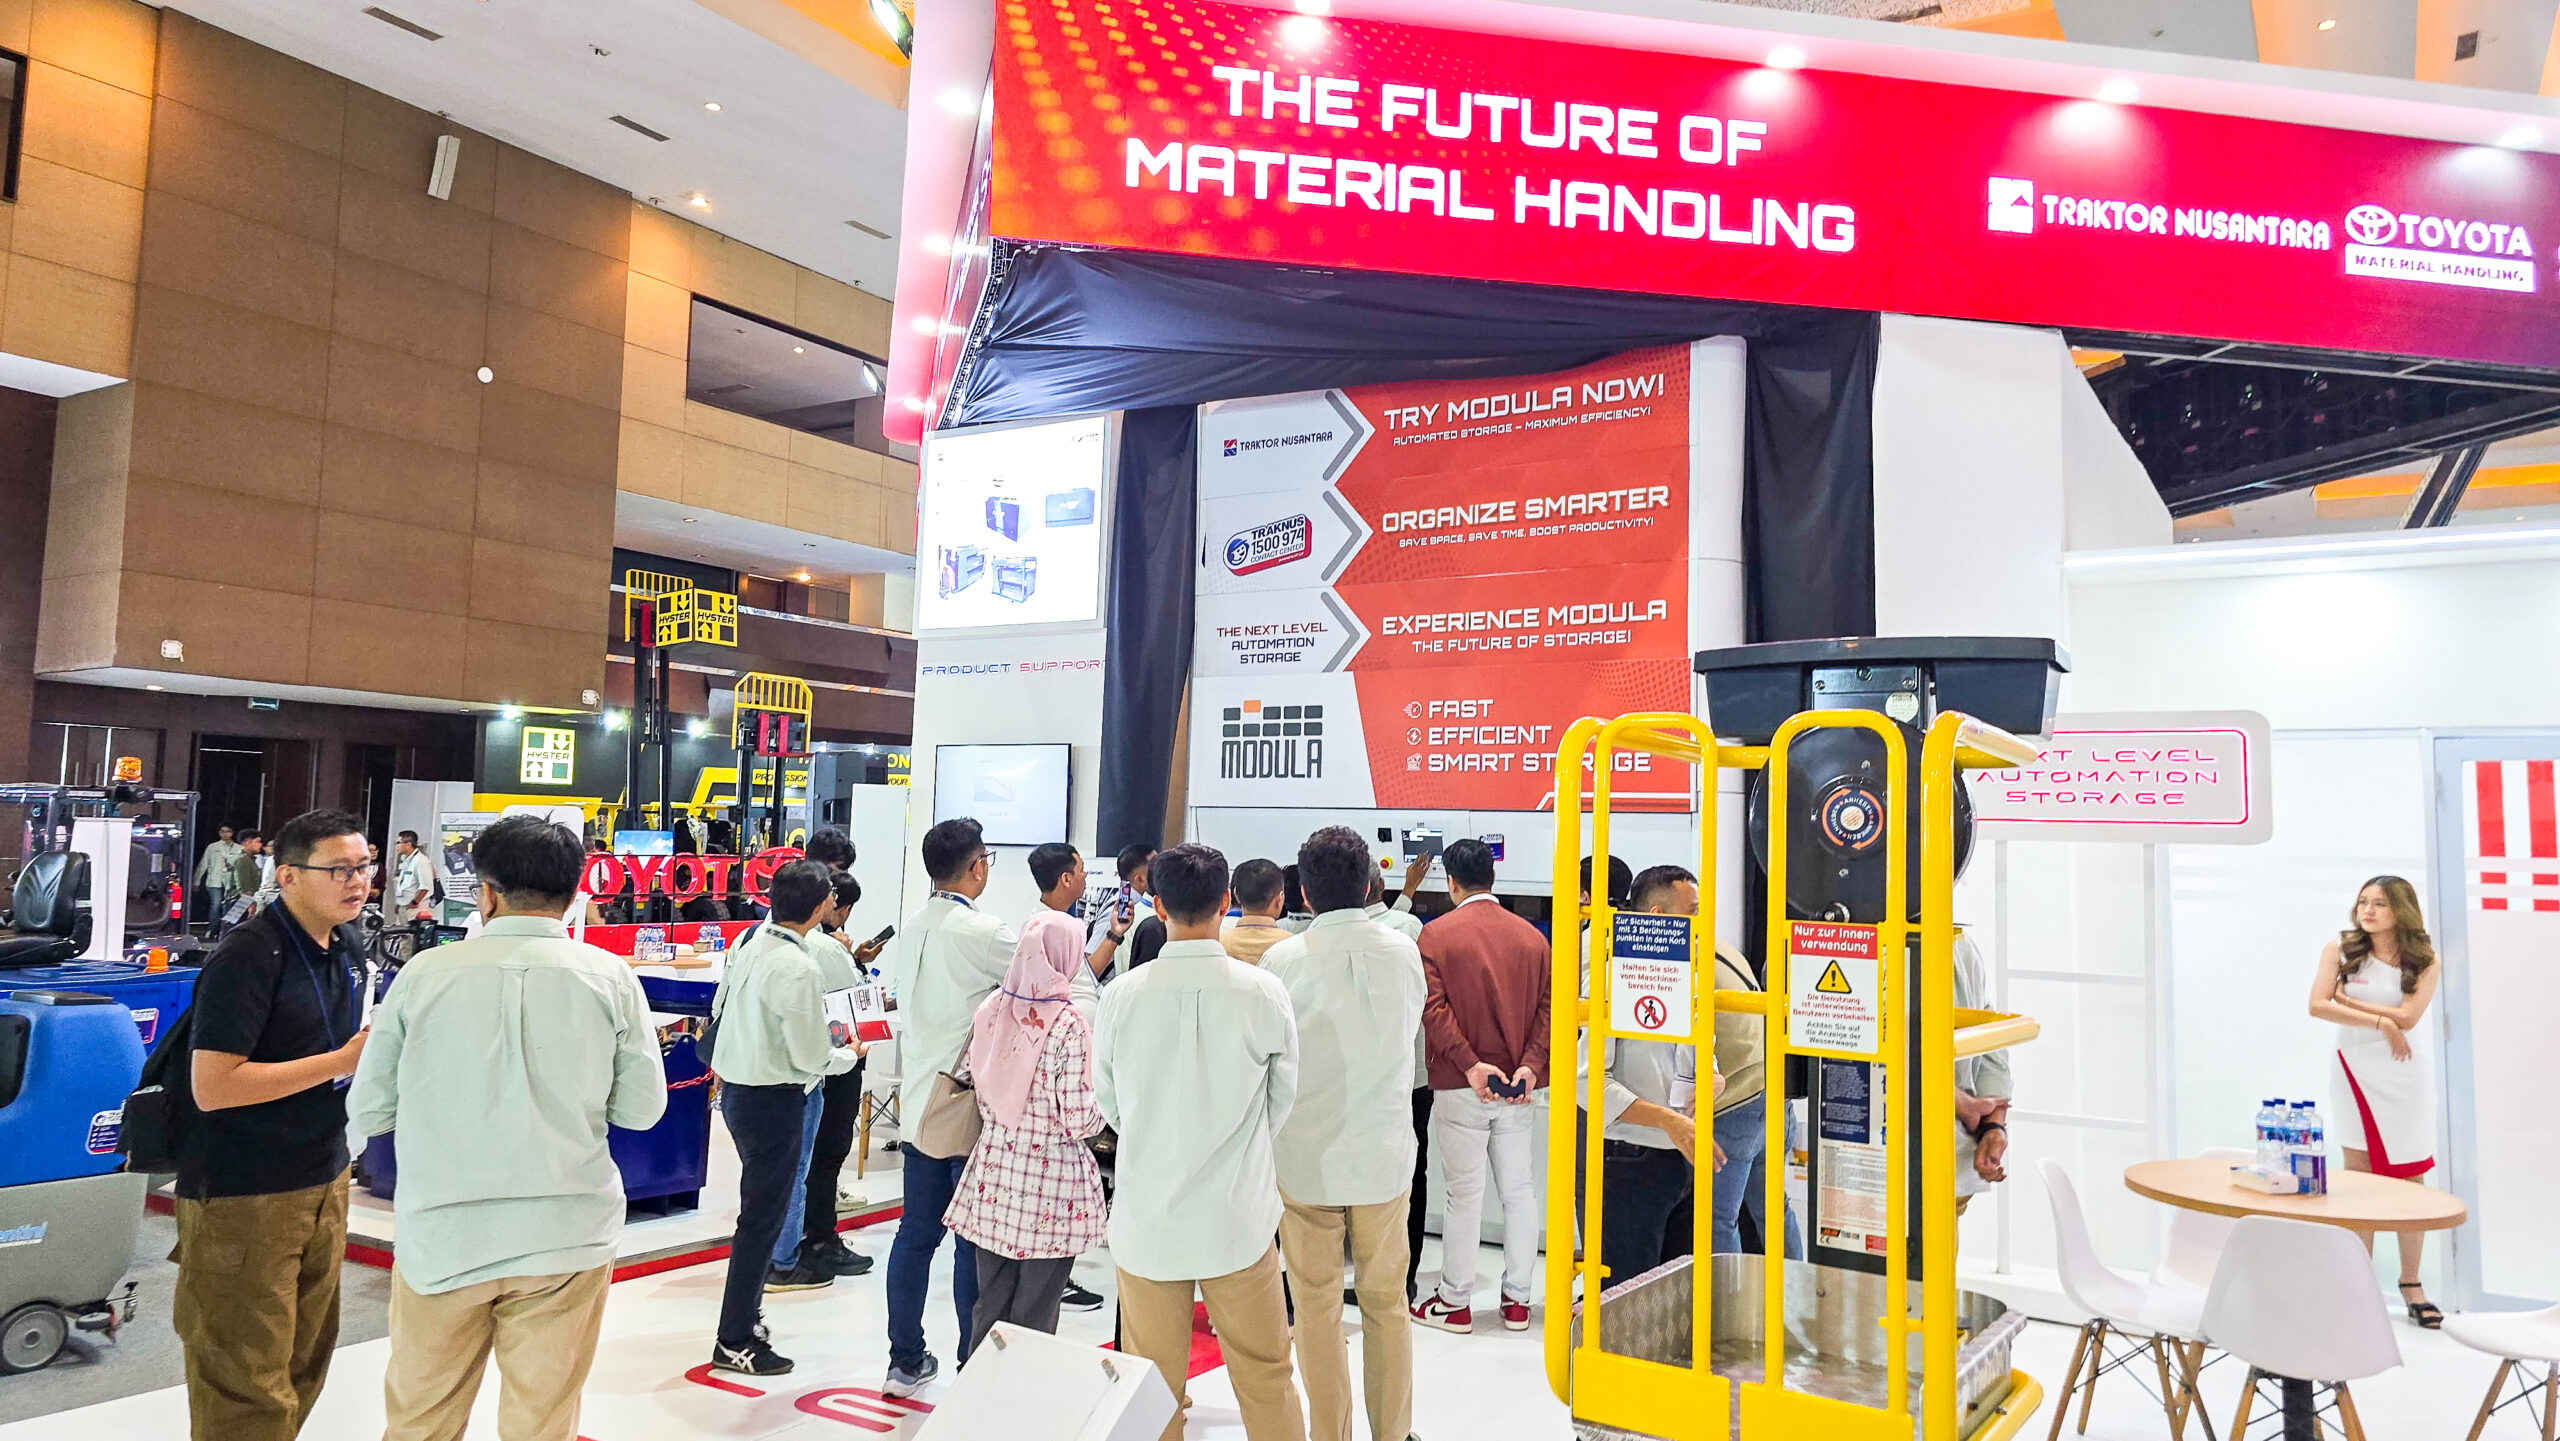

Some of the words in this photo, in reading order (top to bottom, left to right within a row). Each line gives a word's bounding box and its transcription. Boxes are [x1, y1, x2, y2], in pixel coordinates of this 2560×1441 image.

[1212, 65, 1360, 129] THE
[1381, 83, 1659, 159] FUTURE
[1679, 114, 1768, 167] OF
[1125, 137, 1495, 221] MATERIAL
[1514, 175, 1856, 253] HANDLING
[2042, 194, 2168, 235] TRAKTOR
[2174, 207, 2331, 251] NUSANTARA
[2398, 213, 2534, 257] TOYOTA
[2355, 254, 2436, 273] MATERIAL
[2441, 263, 2524, 282] HANDLING
[1383, 402, 1441, 430] TRY
[1447, 386, 1573, 423] MODULA
[1581, 373, 1665, 405] NOW!
[1393, 430, 1458, 446] AUTOMATED
[1461, 423, 1512, 438] STORAGE
[1525, 415, 1578, 431] MAXIMUM
[1580, 406, 1651, 424] EFFICIENCY!
[1240, 438, 1279, 451] TRAKTOR
[1281, 431, 1333, 447] NUSANTARA
[1382, 500, 1517, 533] ORGANIZE
[1524, 485, 1670, 520] SMARTER
[1251, 516, 1304, 540] TRAKNUS
[1399, 537, 1428, 548] SAVE
[1429, 533, 1466, 545] SPACE,
[1468, 530, 1498, 541] SAVE
[1500, 528, 1527, 539] TIME,
[1529, 525, 1566, 537] BOOST
[1569, 516, 1655, 534] PRODUCTIVITY!
[1251, 534, 1280, 555] 1500
[1282, 527, 1304, 546] 974
[1250, 550, 1278, 563] CONTACT
[658, 611, 691, 624] HYSTER
[697, 611, 735, 625] HYSTER
[1382, 607, 1540, 635] EXPERIENCE
[1547, 599, 1668, 627] MODULA
[1216, 626, 1242, 638] THE
[1244, 624, 1279, 636] NEXT
[1282, 622, 1328, 634] LEVEL
[1231, 636, 1315, 651] AUTOMATION
[1412, 639, 1444, 653] THE
[1448, 636, 1513, 652] FUTURE
[1517, 634, 1540, 648] OF
[1543, 629, 1632, 647] STORAGE!
[1240, 651, 1302, 664] STORAGE
[922, 663, 1012, 675] PRODUCT
[1427, 699, 1494, 718] FAST
[1427, 725, 1552, 745] EFFICIENT
[526, 750, 570, 761] HYSTER
[1220, 739, 1323, 779] MODULA
[1427, 752, 1516, 772] SMART
[2091, 749, 2216, 763] LEVEL
[1976, 769, 2218, 785] AUTOMATION
[2006, 790, 2185, 806] STORAGE
[1616, 916, 1628, 925] Zur
[1630, 917, 1666, 927] Sicherheit
[1673, 920, 1687, 928] Nur
[1632, 926, 1638, 934] 3
[1615, 934, 1644, 942] punkten
[1645, 935, 1653, 943] in
[1669, 937, 1686, 945] Korb
[1794, 924, 1815, 936] Nur
[1817, 928, 1837, 937] zur
[1839, 927, 1875, 940] Innen-
[1632, 943, 1669, 953] einsteigen
[1801, 939, 1868, 954] verwendung
